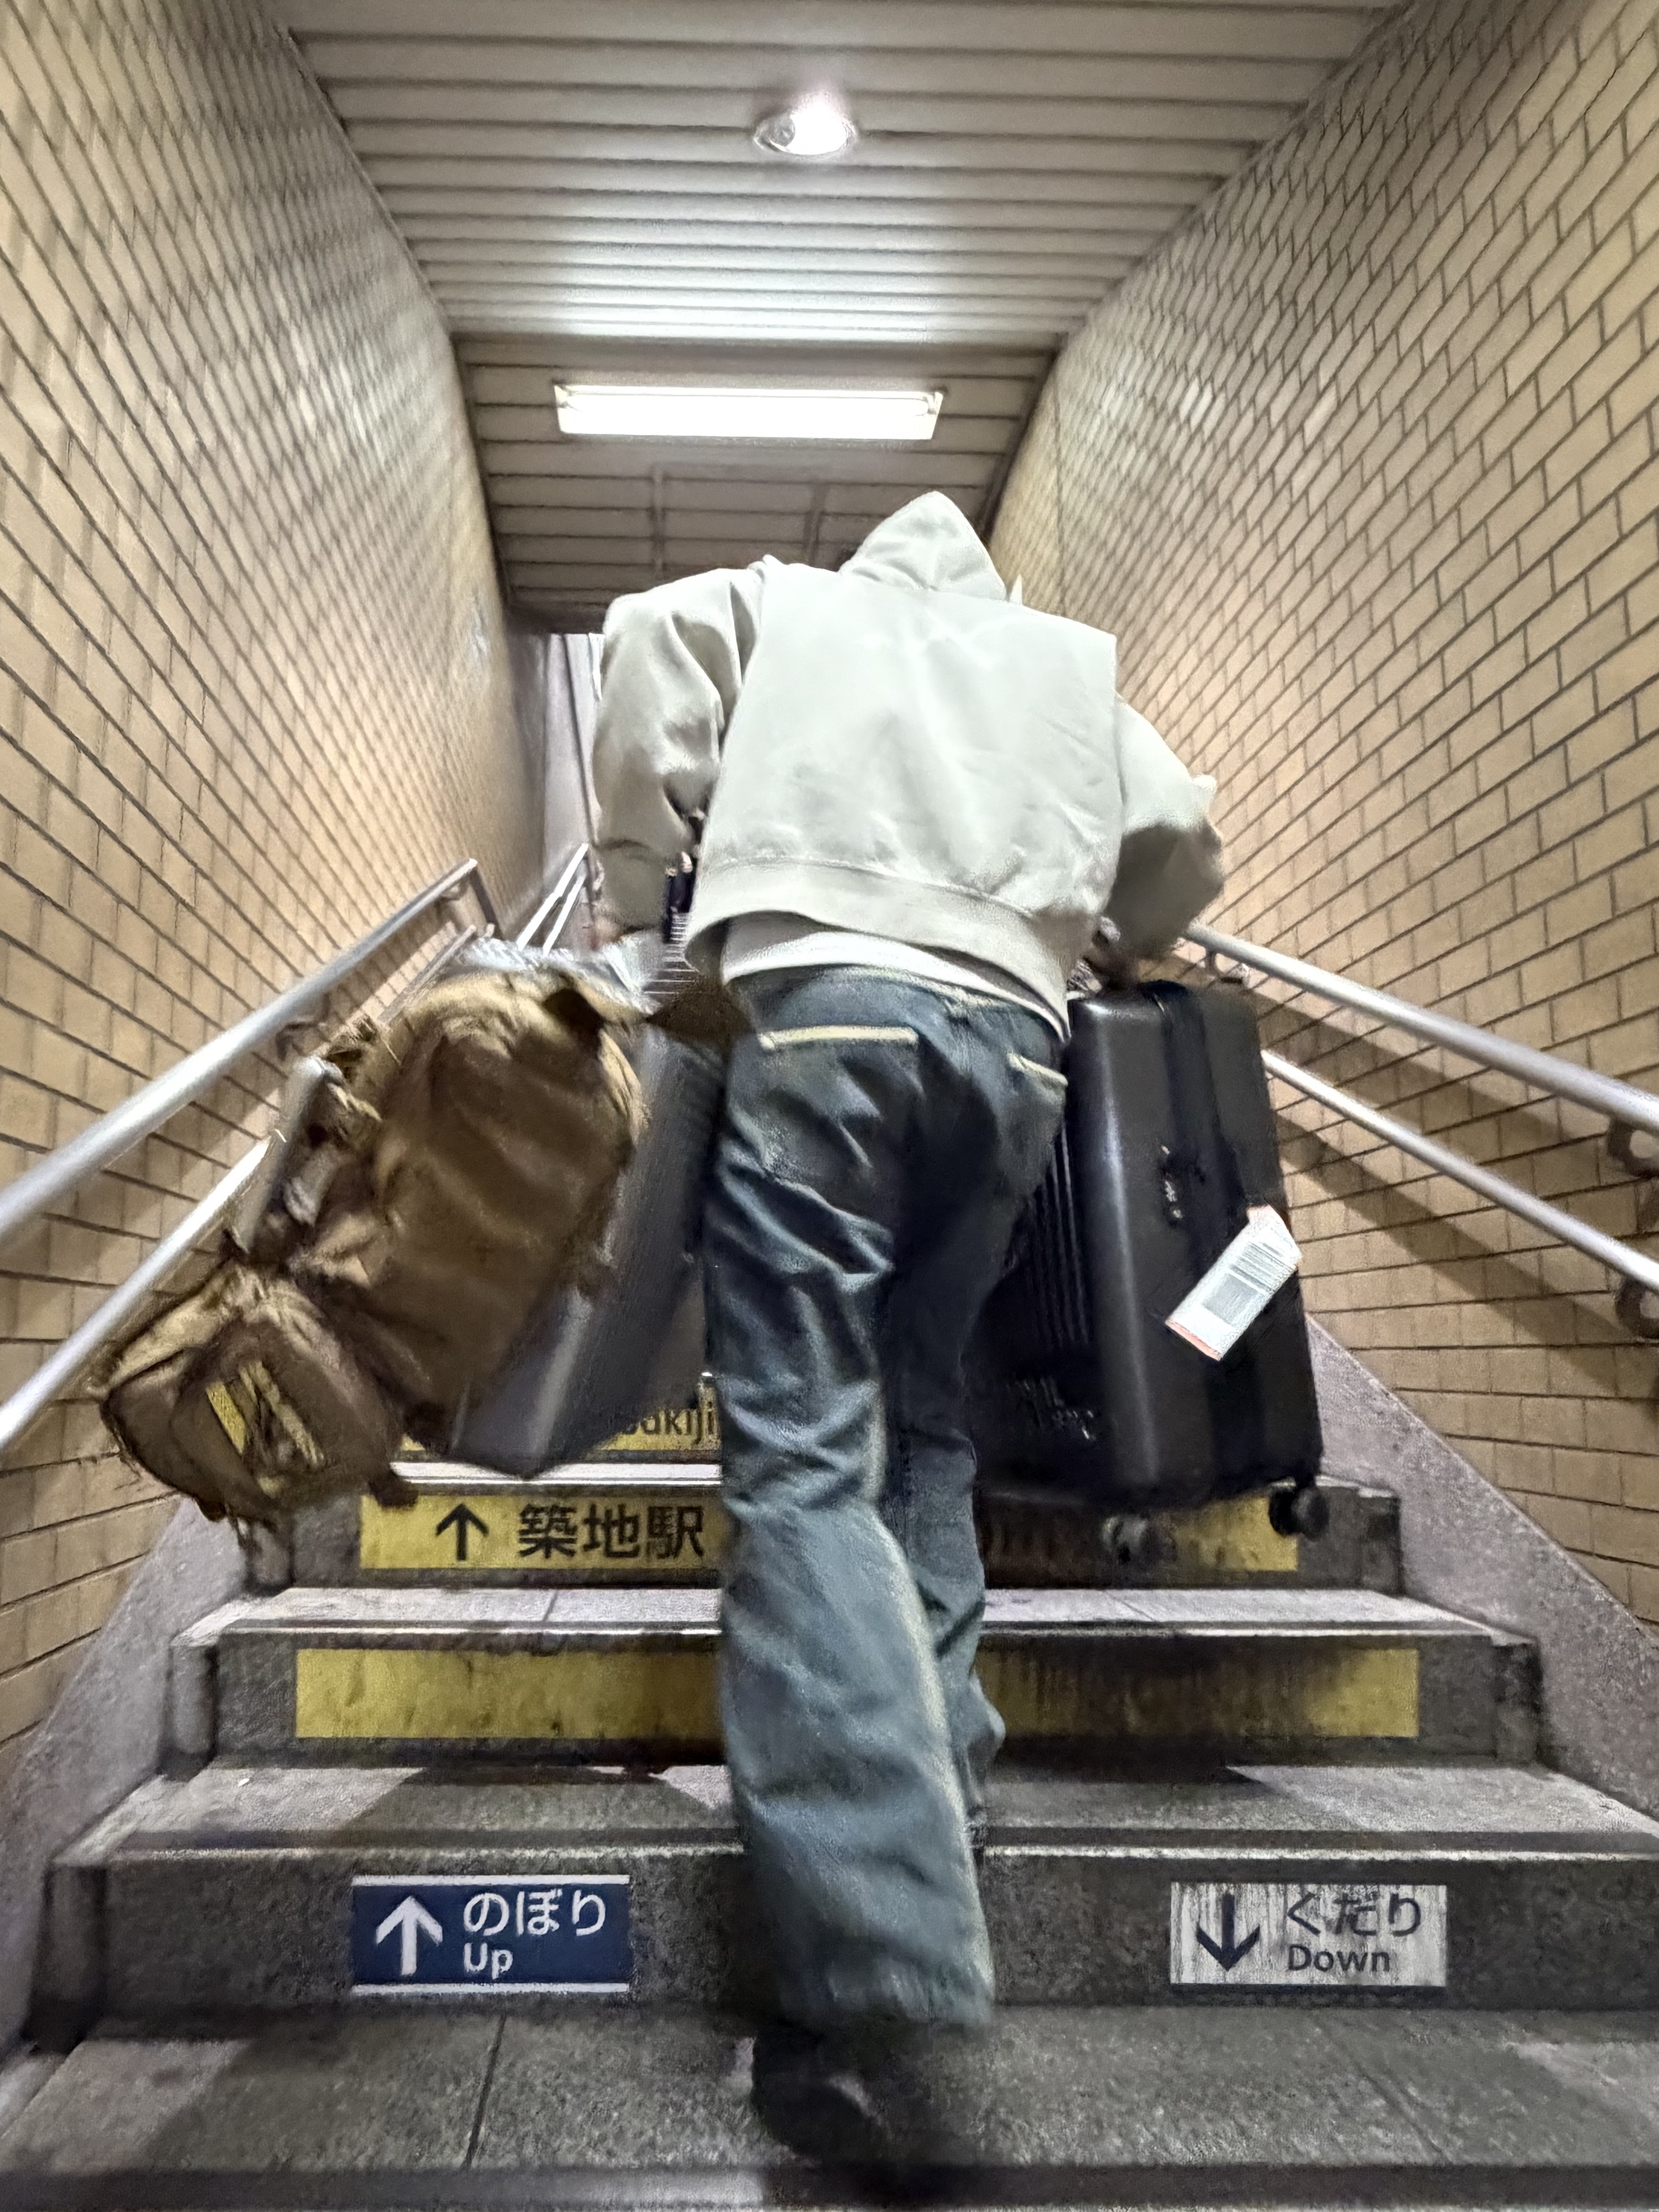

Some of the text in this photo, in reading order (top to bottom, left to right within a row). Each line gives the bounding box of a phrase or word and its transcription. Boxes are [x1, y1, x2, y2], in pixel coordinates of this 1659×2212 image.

[518, 1503, 704, 1559] 築地駅
[463, 1889, 606, 1936] のぼり
[1287, 1892, 1421, 1937] くだり
[463, 1942, 514, 1980] Up
[1288, 1944, 1391, 1972] Down
